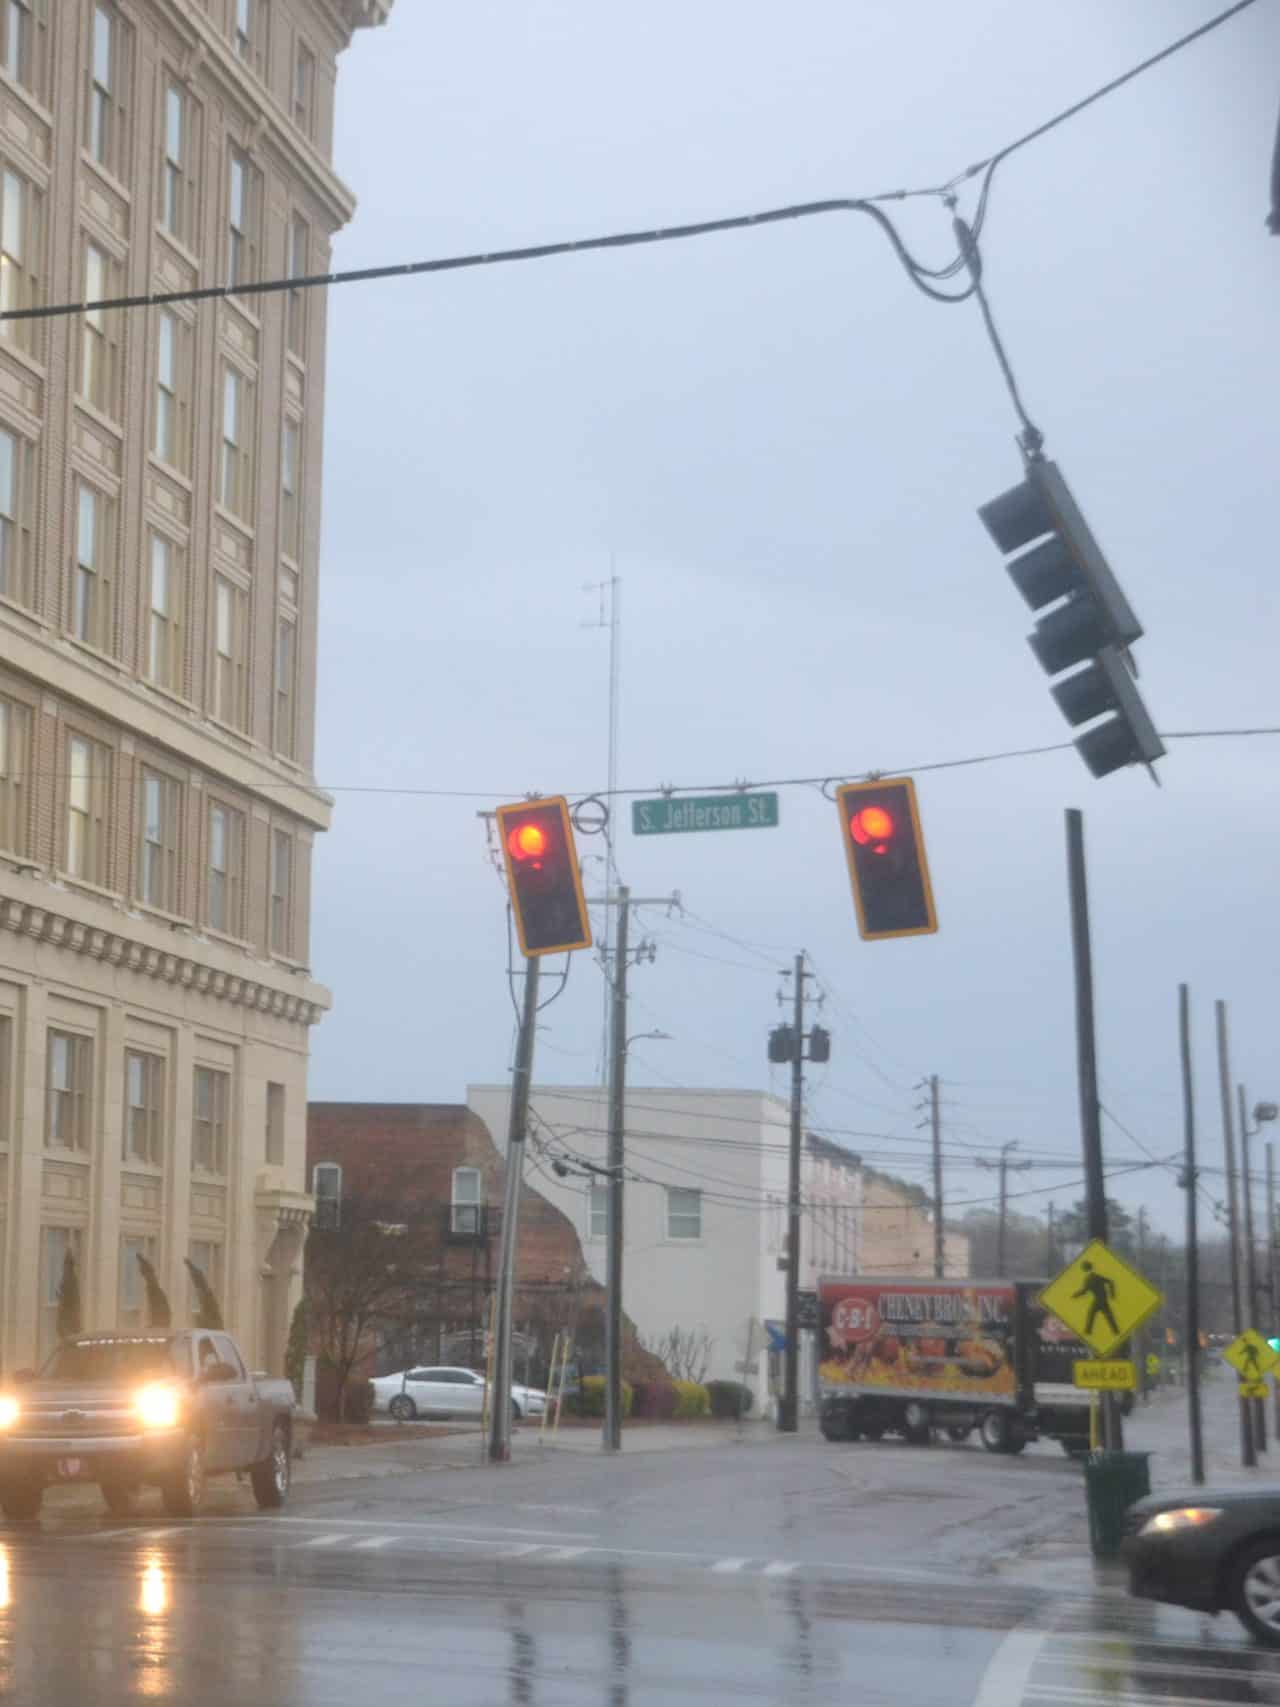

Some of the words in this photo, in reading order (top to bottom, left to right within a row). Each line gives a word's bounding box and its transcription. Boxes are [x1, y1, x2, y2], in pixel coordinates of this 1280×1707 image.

[639, 805, 657, 830] S.
[663, 801, 741, 828] Jefferson
[747, 797, 771, 823] St.
[1081, 1367, 1127, 1381] AHEAD
